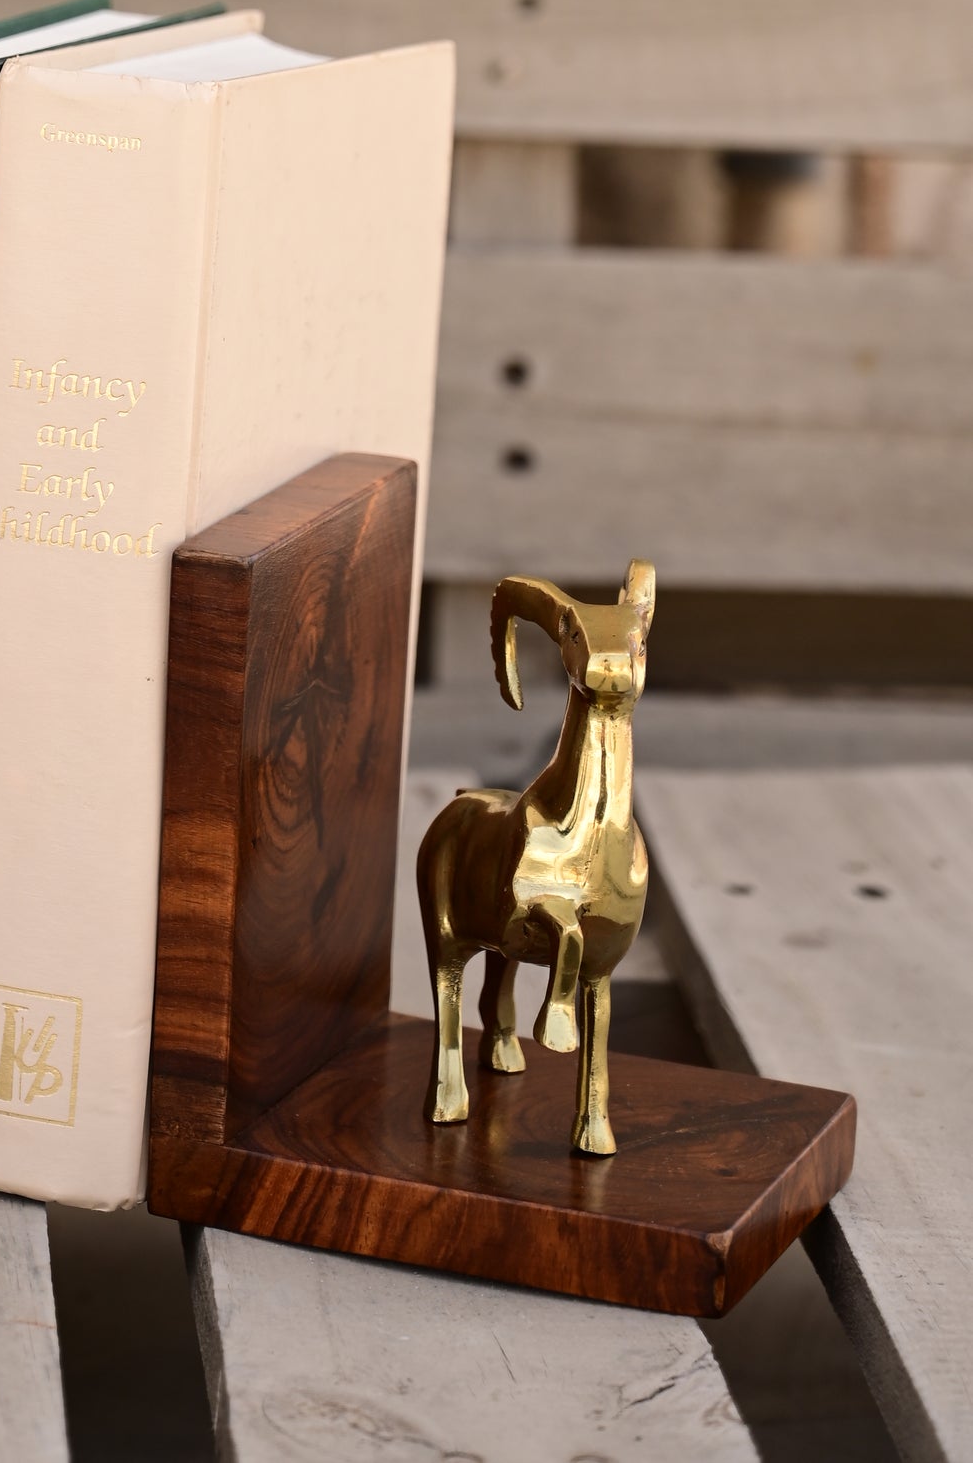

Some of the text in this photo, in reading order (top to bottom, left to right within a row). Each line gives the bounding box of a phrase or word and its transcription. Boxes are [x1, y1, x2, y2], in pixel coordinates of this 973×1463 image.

[40, 122, 143, 153] Greenspan
[11, 358, 147, 417] Infancy
[36, 418, 107, 453] and
[17, 463, 115, 515] Early
